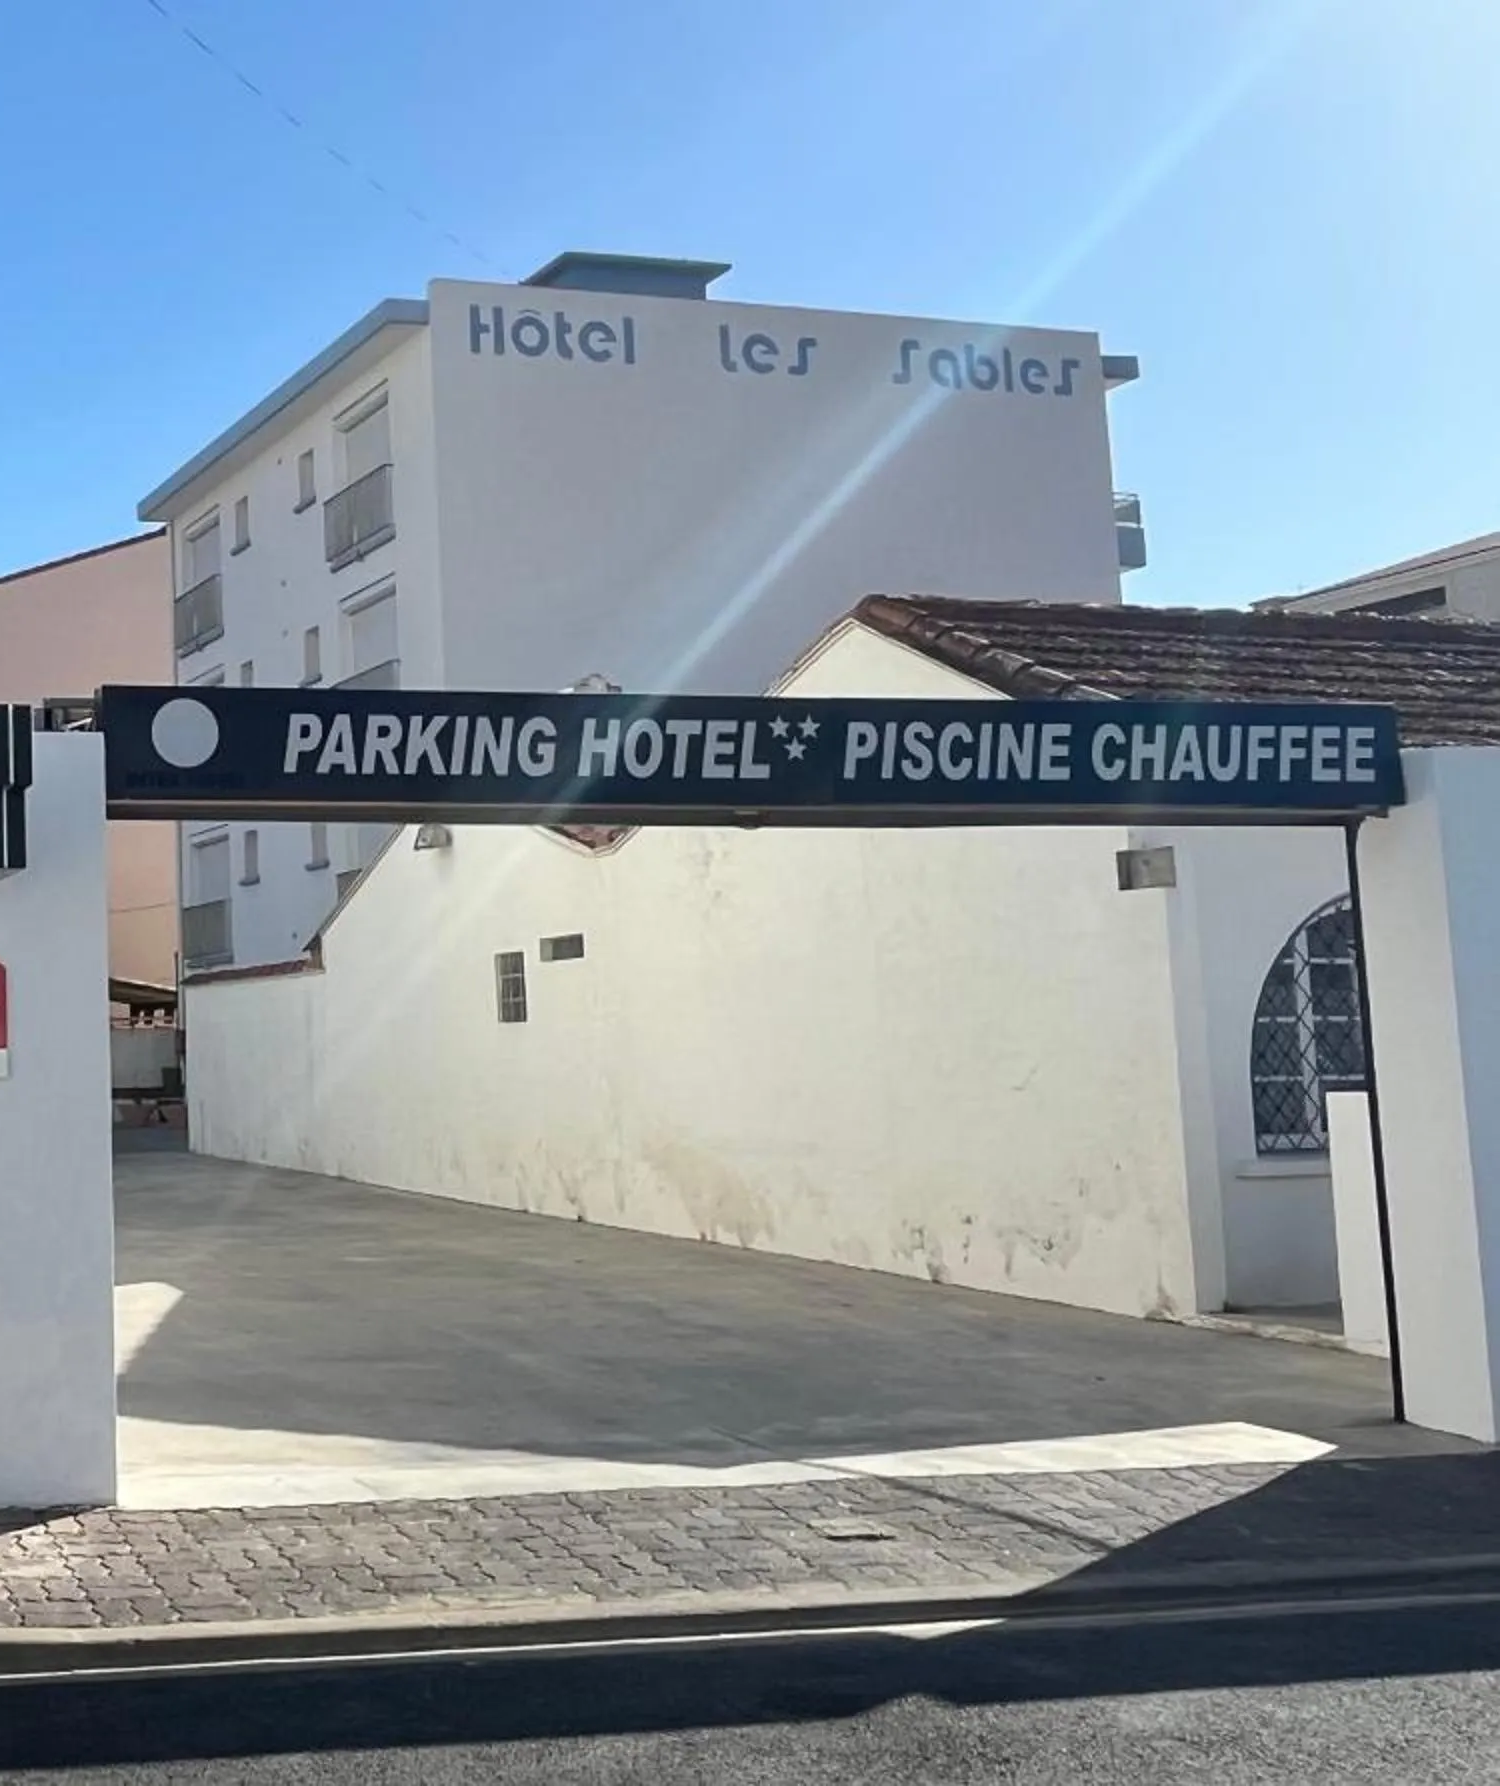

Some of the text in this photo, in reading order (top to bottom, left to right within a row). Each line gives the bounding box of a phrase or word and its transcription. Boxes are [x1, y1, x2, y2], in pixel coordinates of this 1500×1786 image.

[469, 303, 635, 364] Hôtel
[283, 714, 1377, 782] PARKING HOTEL PISCINE CHAUFFEE
